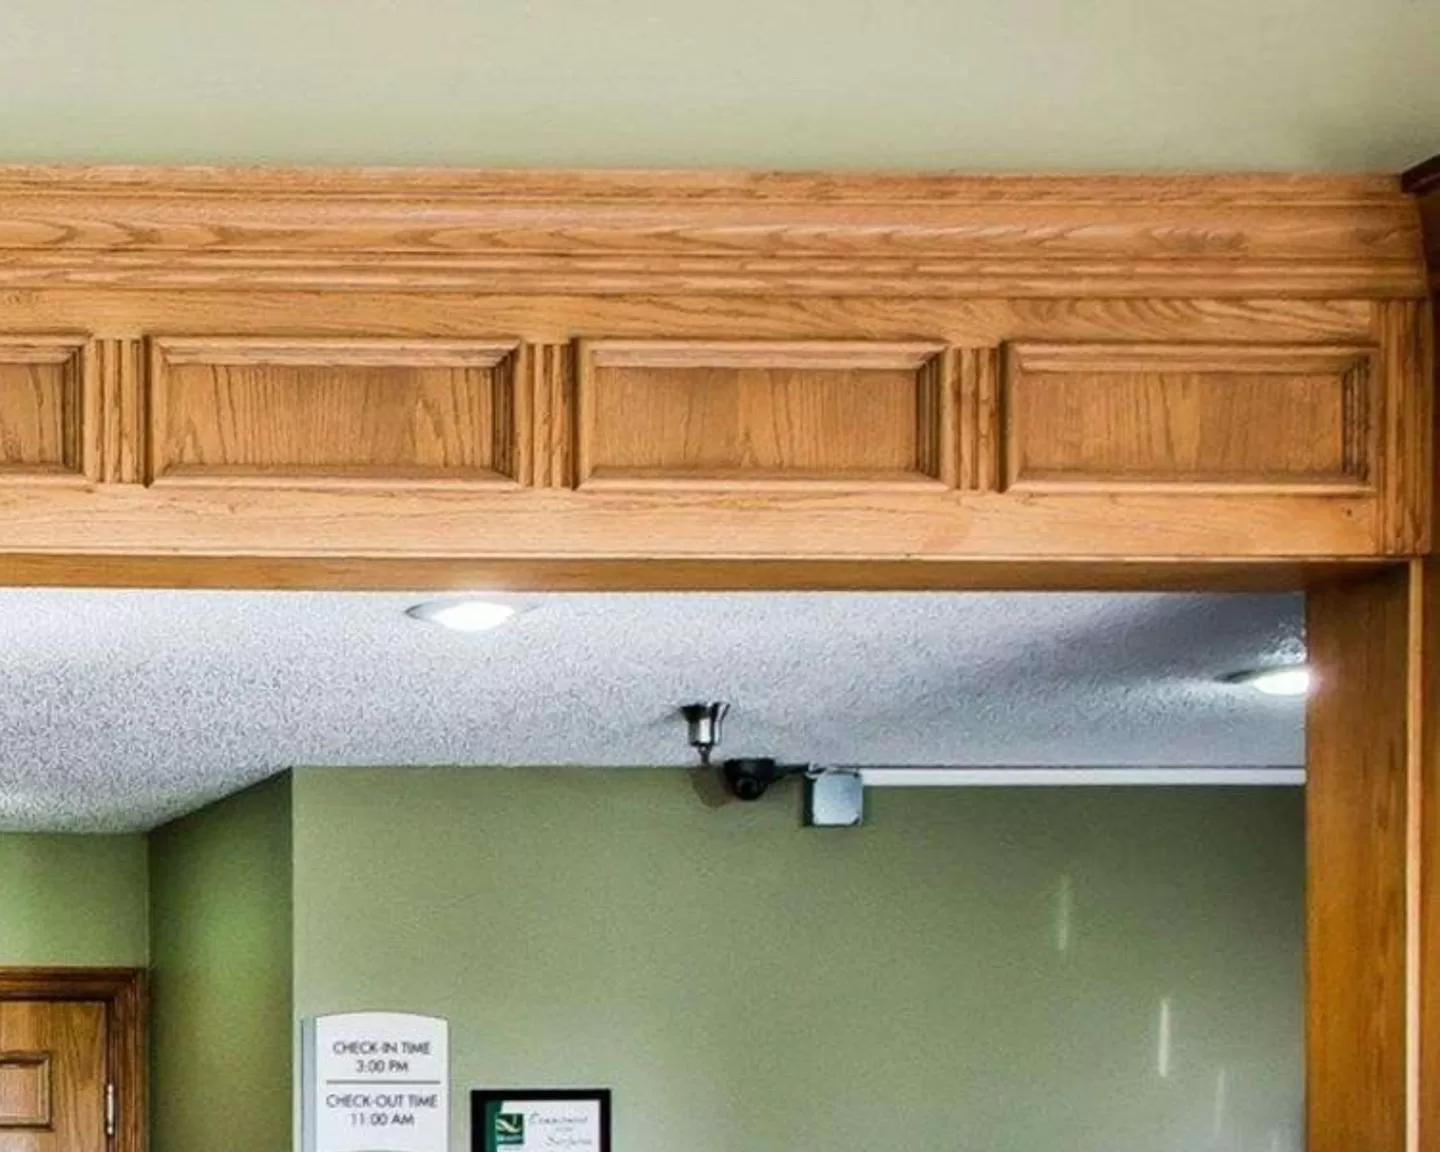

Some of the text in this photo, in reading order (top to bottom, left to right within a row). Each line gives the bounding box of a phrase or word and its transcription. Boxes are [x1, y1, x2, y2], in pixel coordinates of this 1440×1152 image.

[332, 1041, 431, 1055] CHECK-IN TIME
[356, 1059, 408, 1073] 3:00 PM
[326, 1093, 438, 1108] CHECK-OUT TIME
[351, 1112, 415, 1126] 11:00 AM
